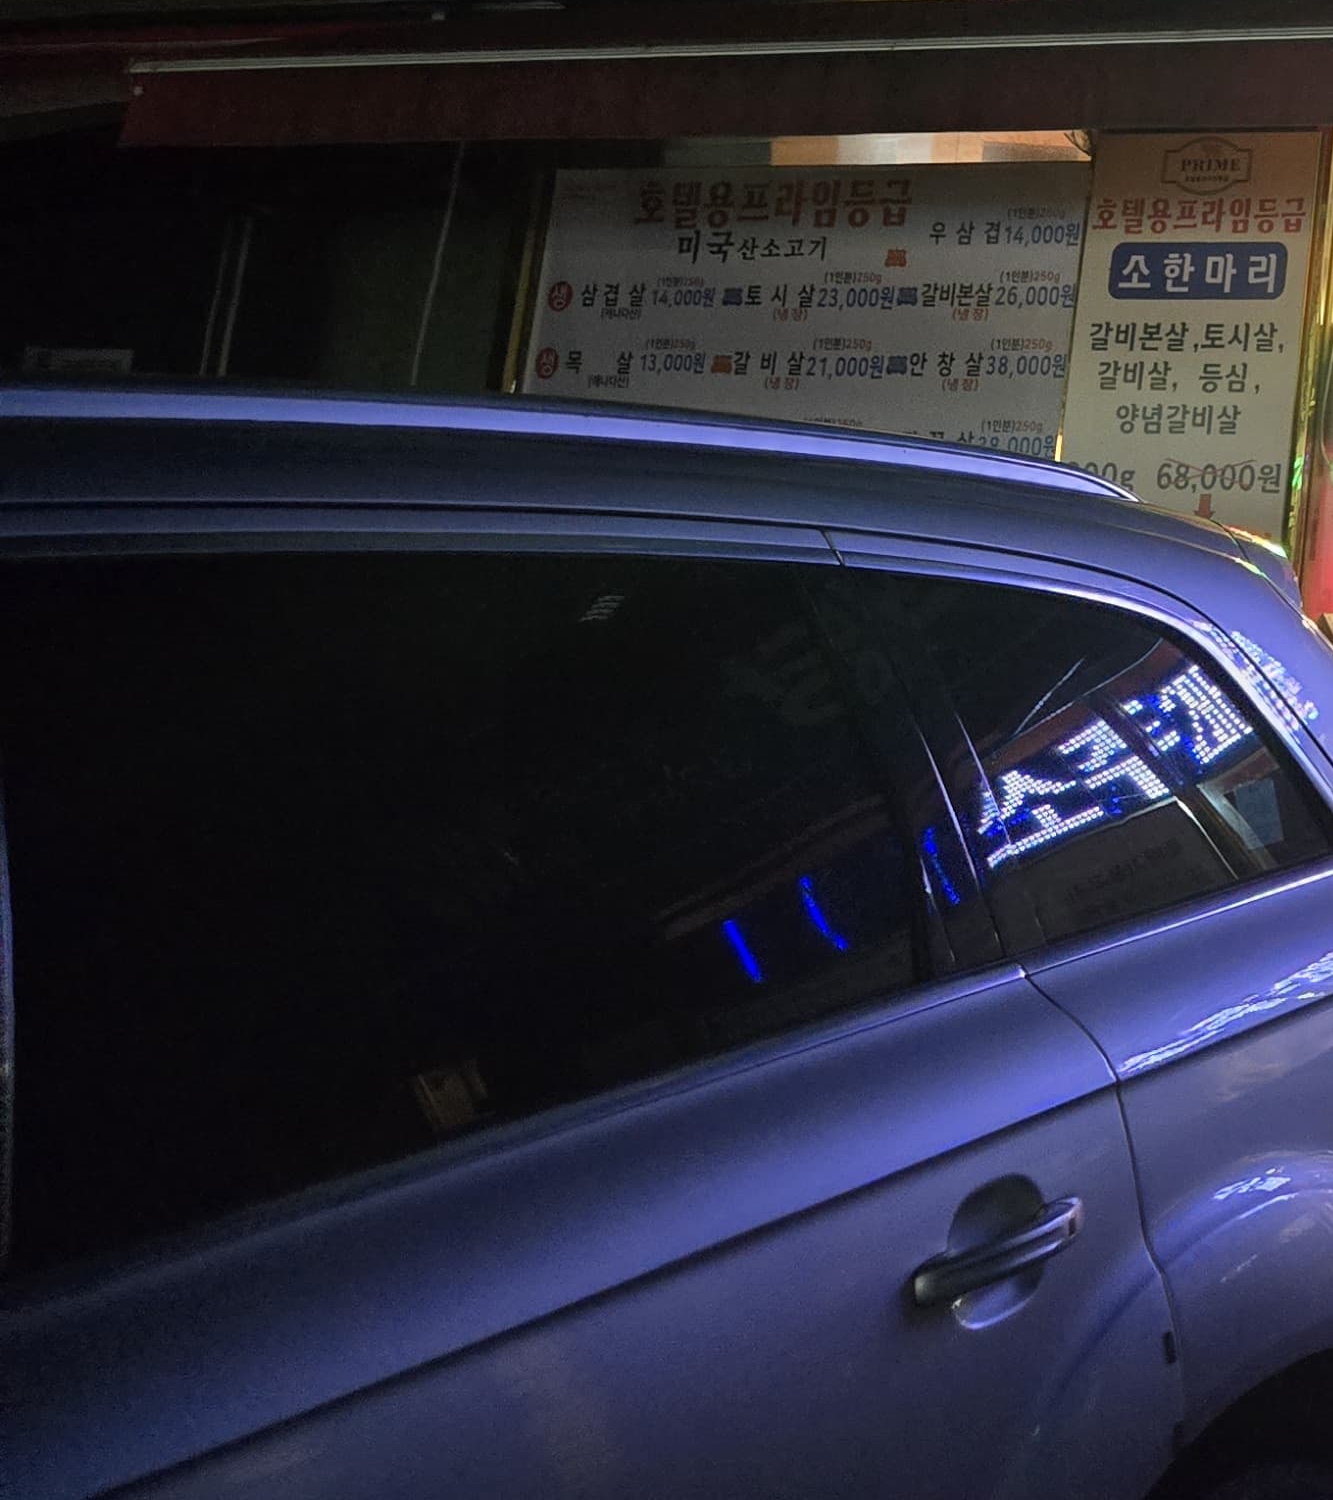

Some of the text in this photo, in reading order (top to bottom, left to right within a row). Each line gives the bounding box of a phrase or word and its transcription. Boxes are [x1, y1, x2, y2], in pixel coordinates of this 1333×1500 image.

[1179, 157, 1241, 172] PRIME
[1092, 199, 1307, 234] 호텔용프라임등급
[1003, 223, 1081, 247] 14,000원
[816, 286, 896, 311] 23,000원
[921, 283, 1076, 309] 갈비본살 26,000원
[805, 355, 884, 379] 21,000원
[986, 353, 1067, 379] 38,000원
[1097, 361, 1178, 391] 갈비살,
[1116, 405, 1242, 435] 양념갈비살
